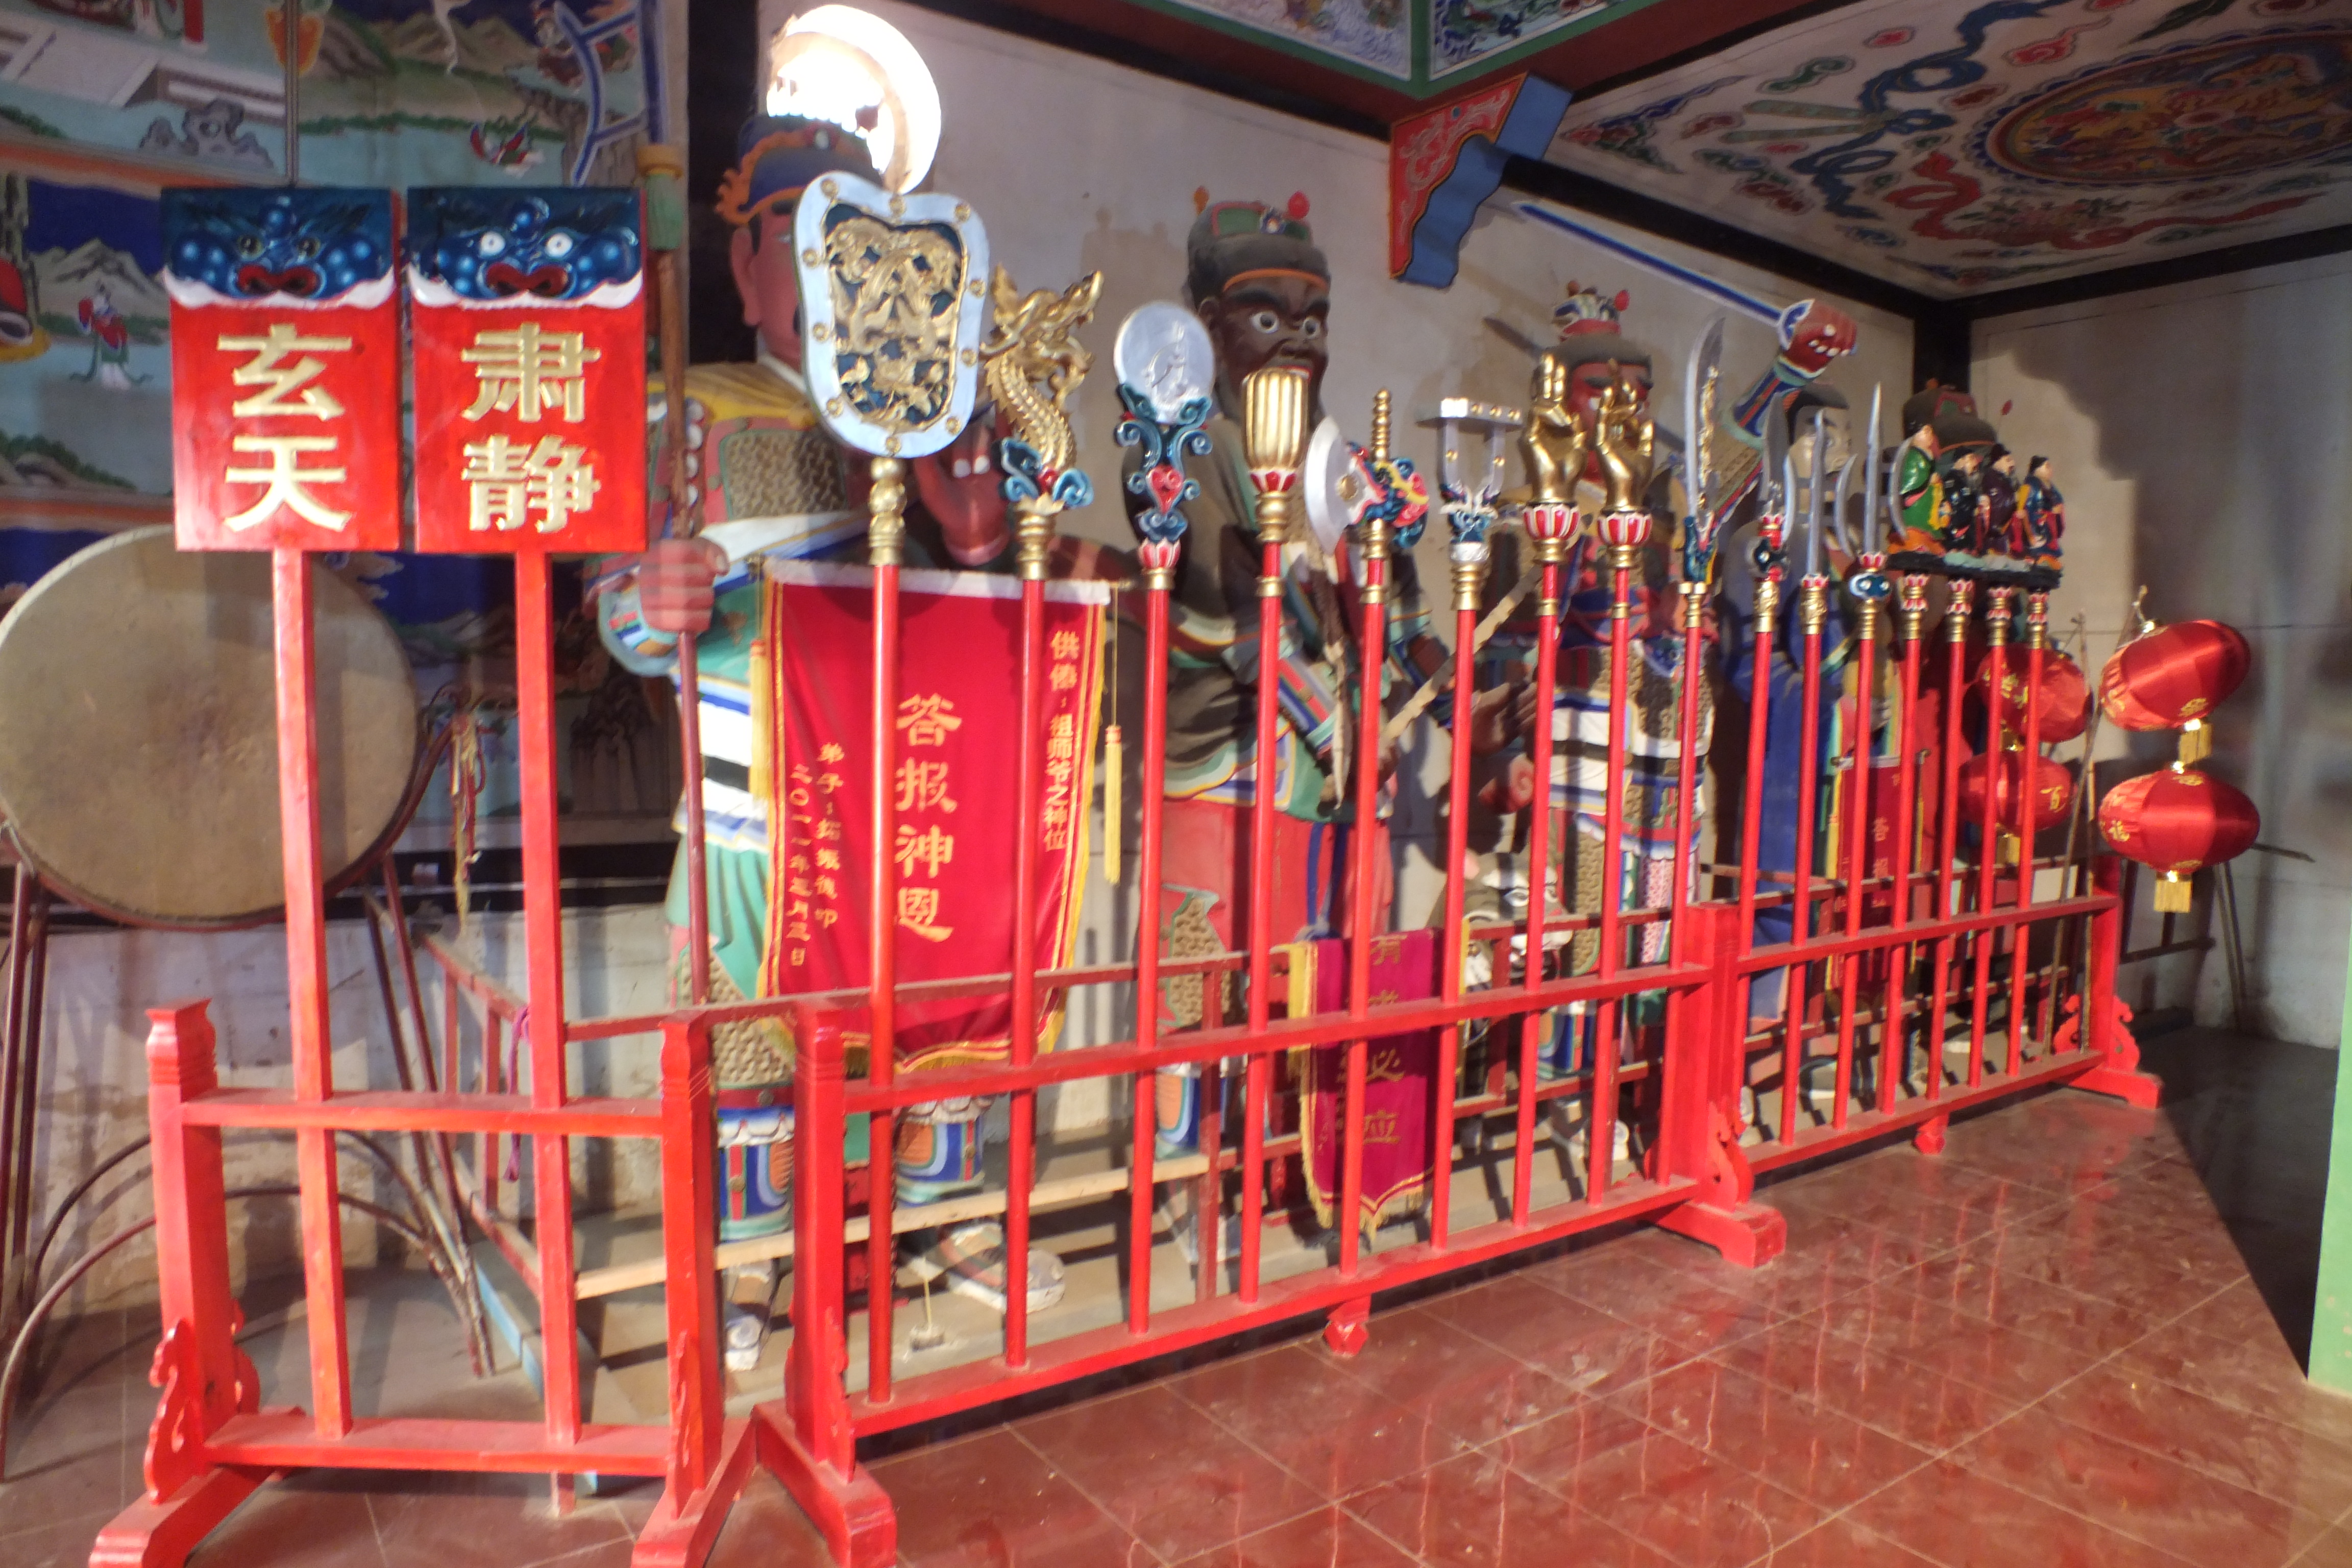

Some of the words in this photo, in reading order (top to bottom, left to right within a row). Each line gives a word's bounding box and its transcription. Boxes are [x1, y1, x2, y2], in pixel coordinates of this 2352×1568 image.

[217, 323, 352, 533] 玄天
[460, 322, 602, 534] 肃静
[1364, 934, 1407, 1144] 有必应
